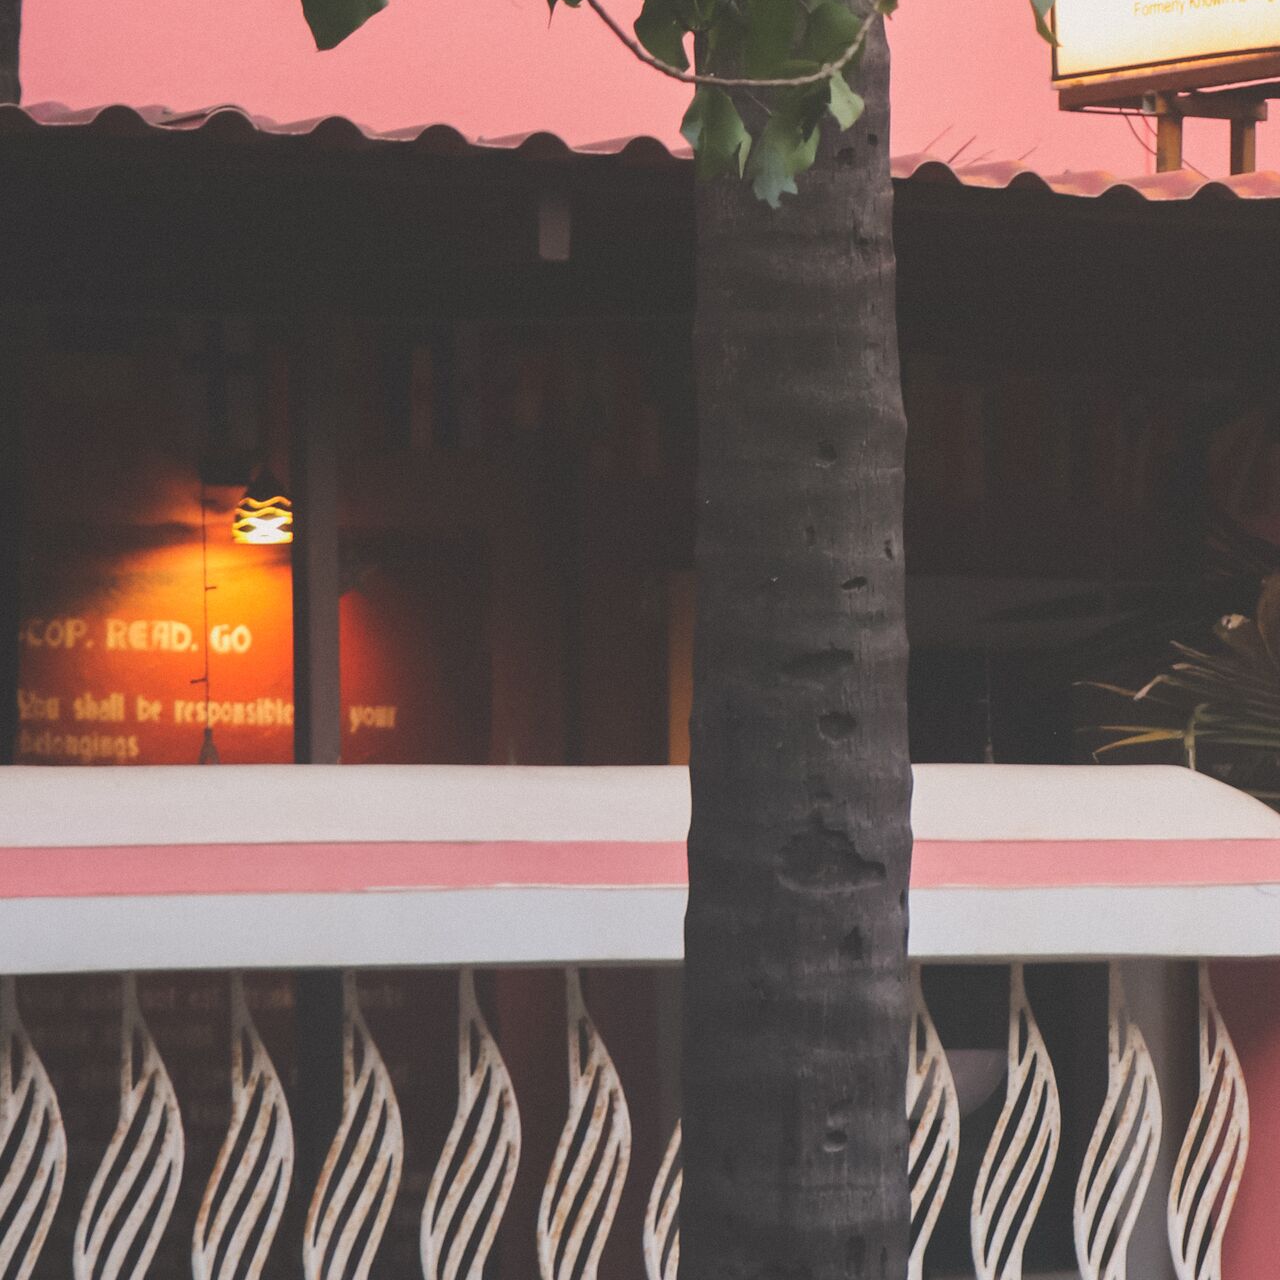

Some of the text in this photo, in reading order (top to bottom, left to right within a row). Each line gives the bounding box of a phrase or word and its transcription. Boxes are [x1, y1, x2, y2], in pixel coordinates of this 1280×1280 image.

[1133, 1, 1185, 17] Formerly
[209, 623, 253, 654] GO
[136, 694, 163, 724] be
